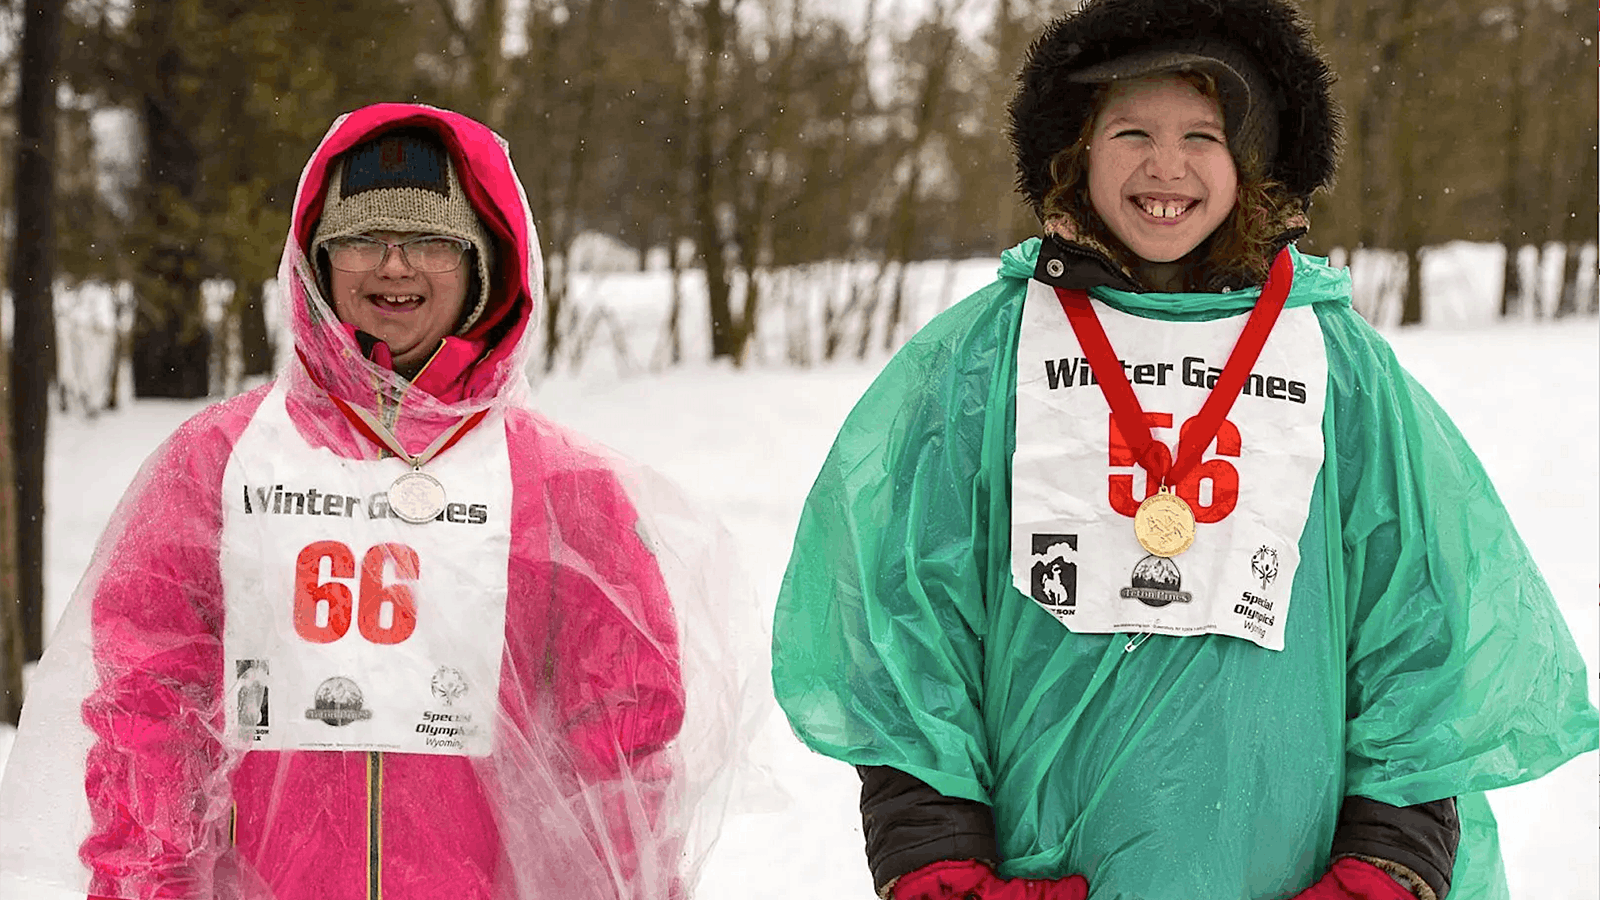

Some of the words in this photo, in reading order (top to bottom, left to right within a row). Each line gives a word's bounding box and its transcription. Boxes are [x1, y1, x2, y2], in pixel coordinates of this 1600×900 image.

[1045, 357, 1174, 390] Witer
[1108, 411, 1242, 524] 56
[368, 491, 488, 525] Ges
[293, 540, 420, 645] 66
